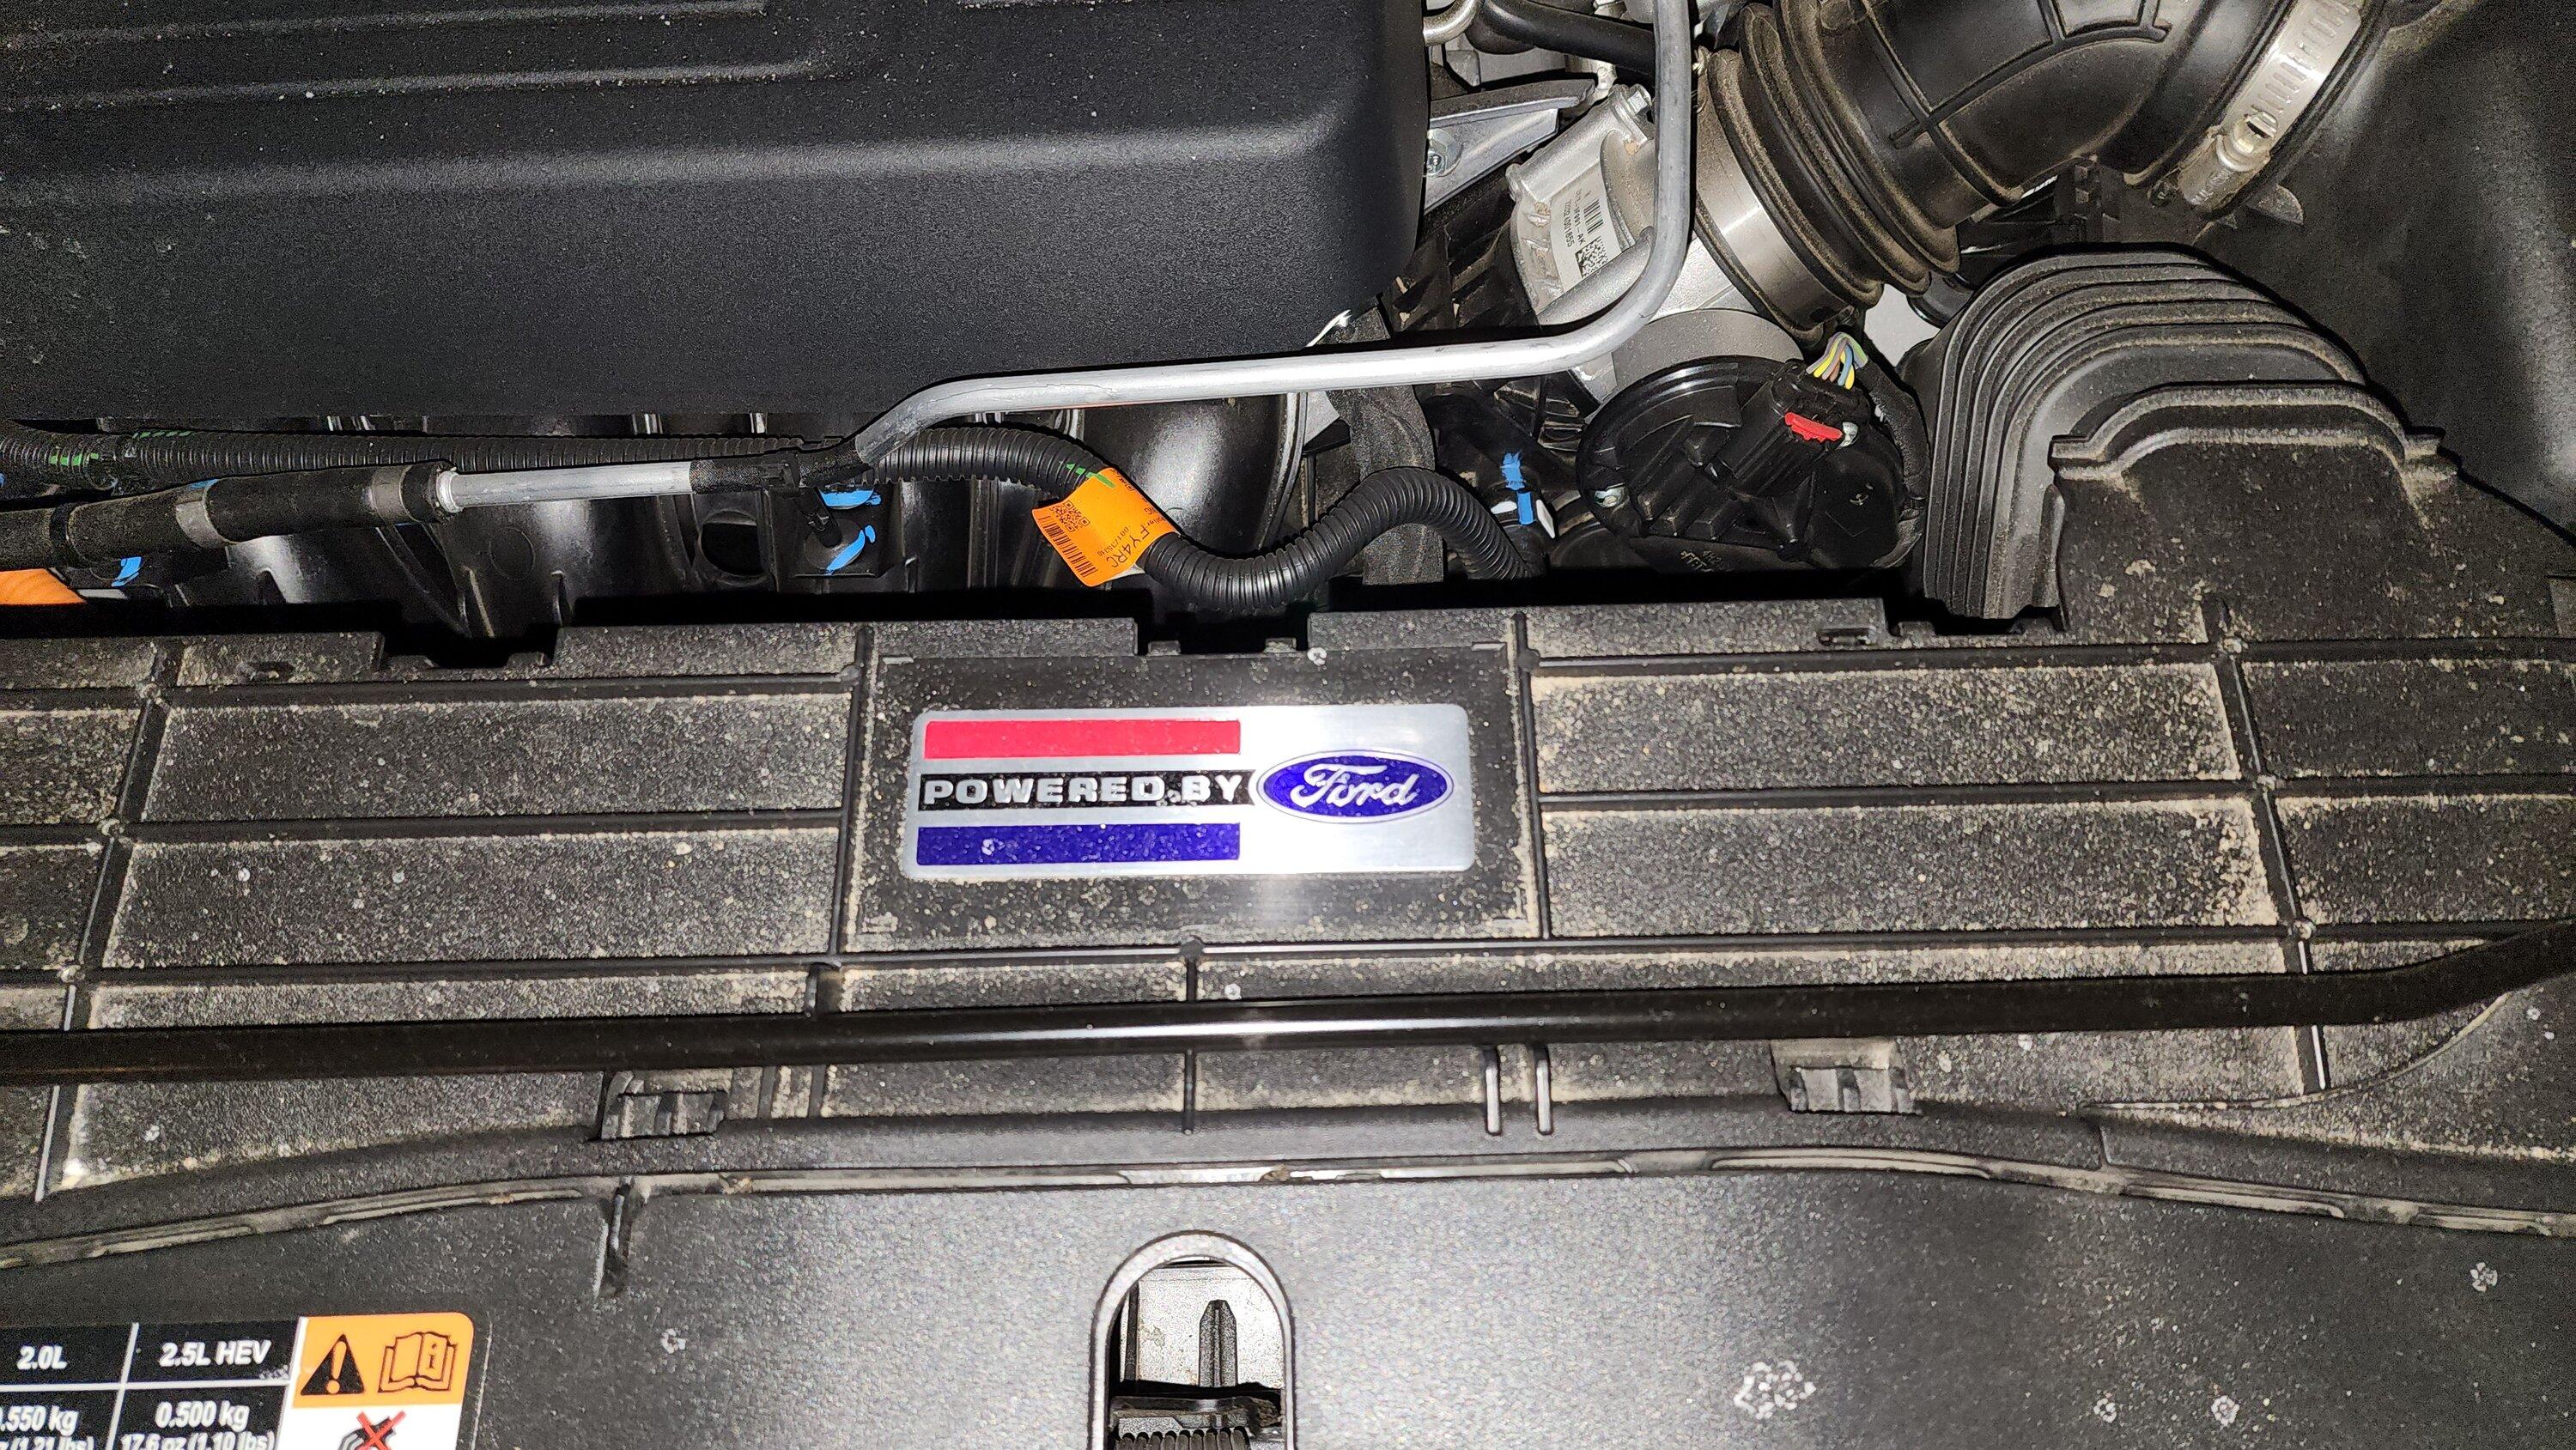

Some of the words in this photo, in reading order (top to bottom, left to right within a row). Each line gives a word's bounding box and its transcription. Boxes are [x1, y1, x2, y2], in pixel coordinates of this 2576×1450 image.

[1106, 525, 1150, 567] FY4RC
[924, 775, 1165, 805] POWERED
[1182, 774, 1242, 803] BY
[1290, 763, 1420, 808] Ford
[15, 1344, 68, 1370] 2.0L
[158, 1341, 211, 1367] 2.5L
[215, 1339, 272, 1366] HEV
[0, 1404, 46, 1432] .550
[48, 1404, 79, 1437] kg
[155, 1400, 217, 1429] 0.500
[218, 1400, 250, 1432] kg
